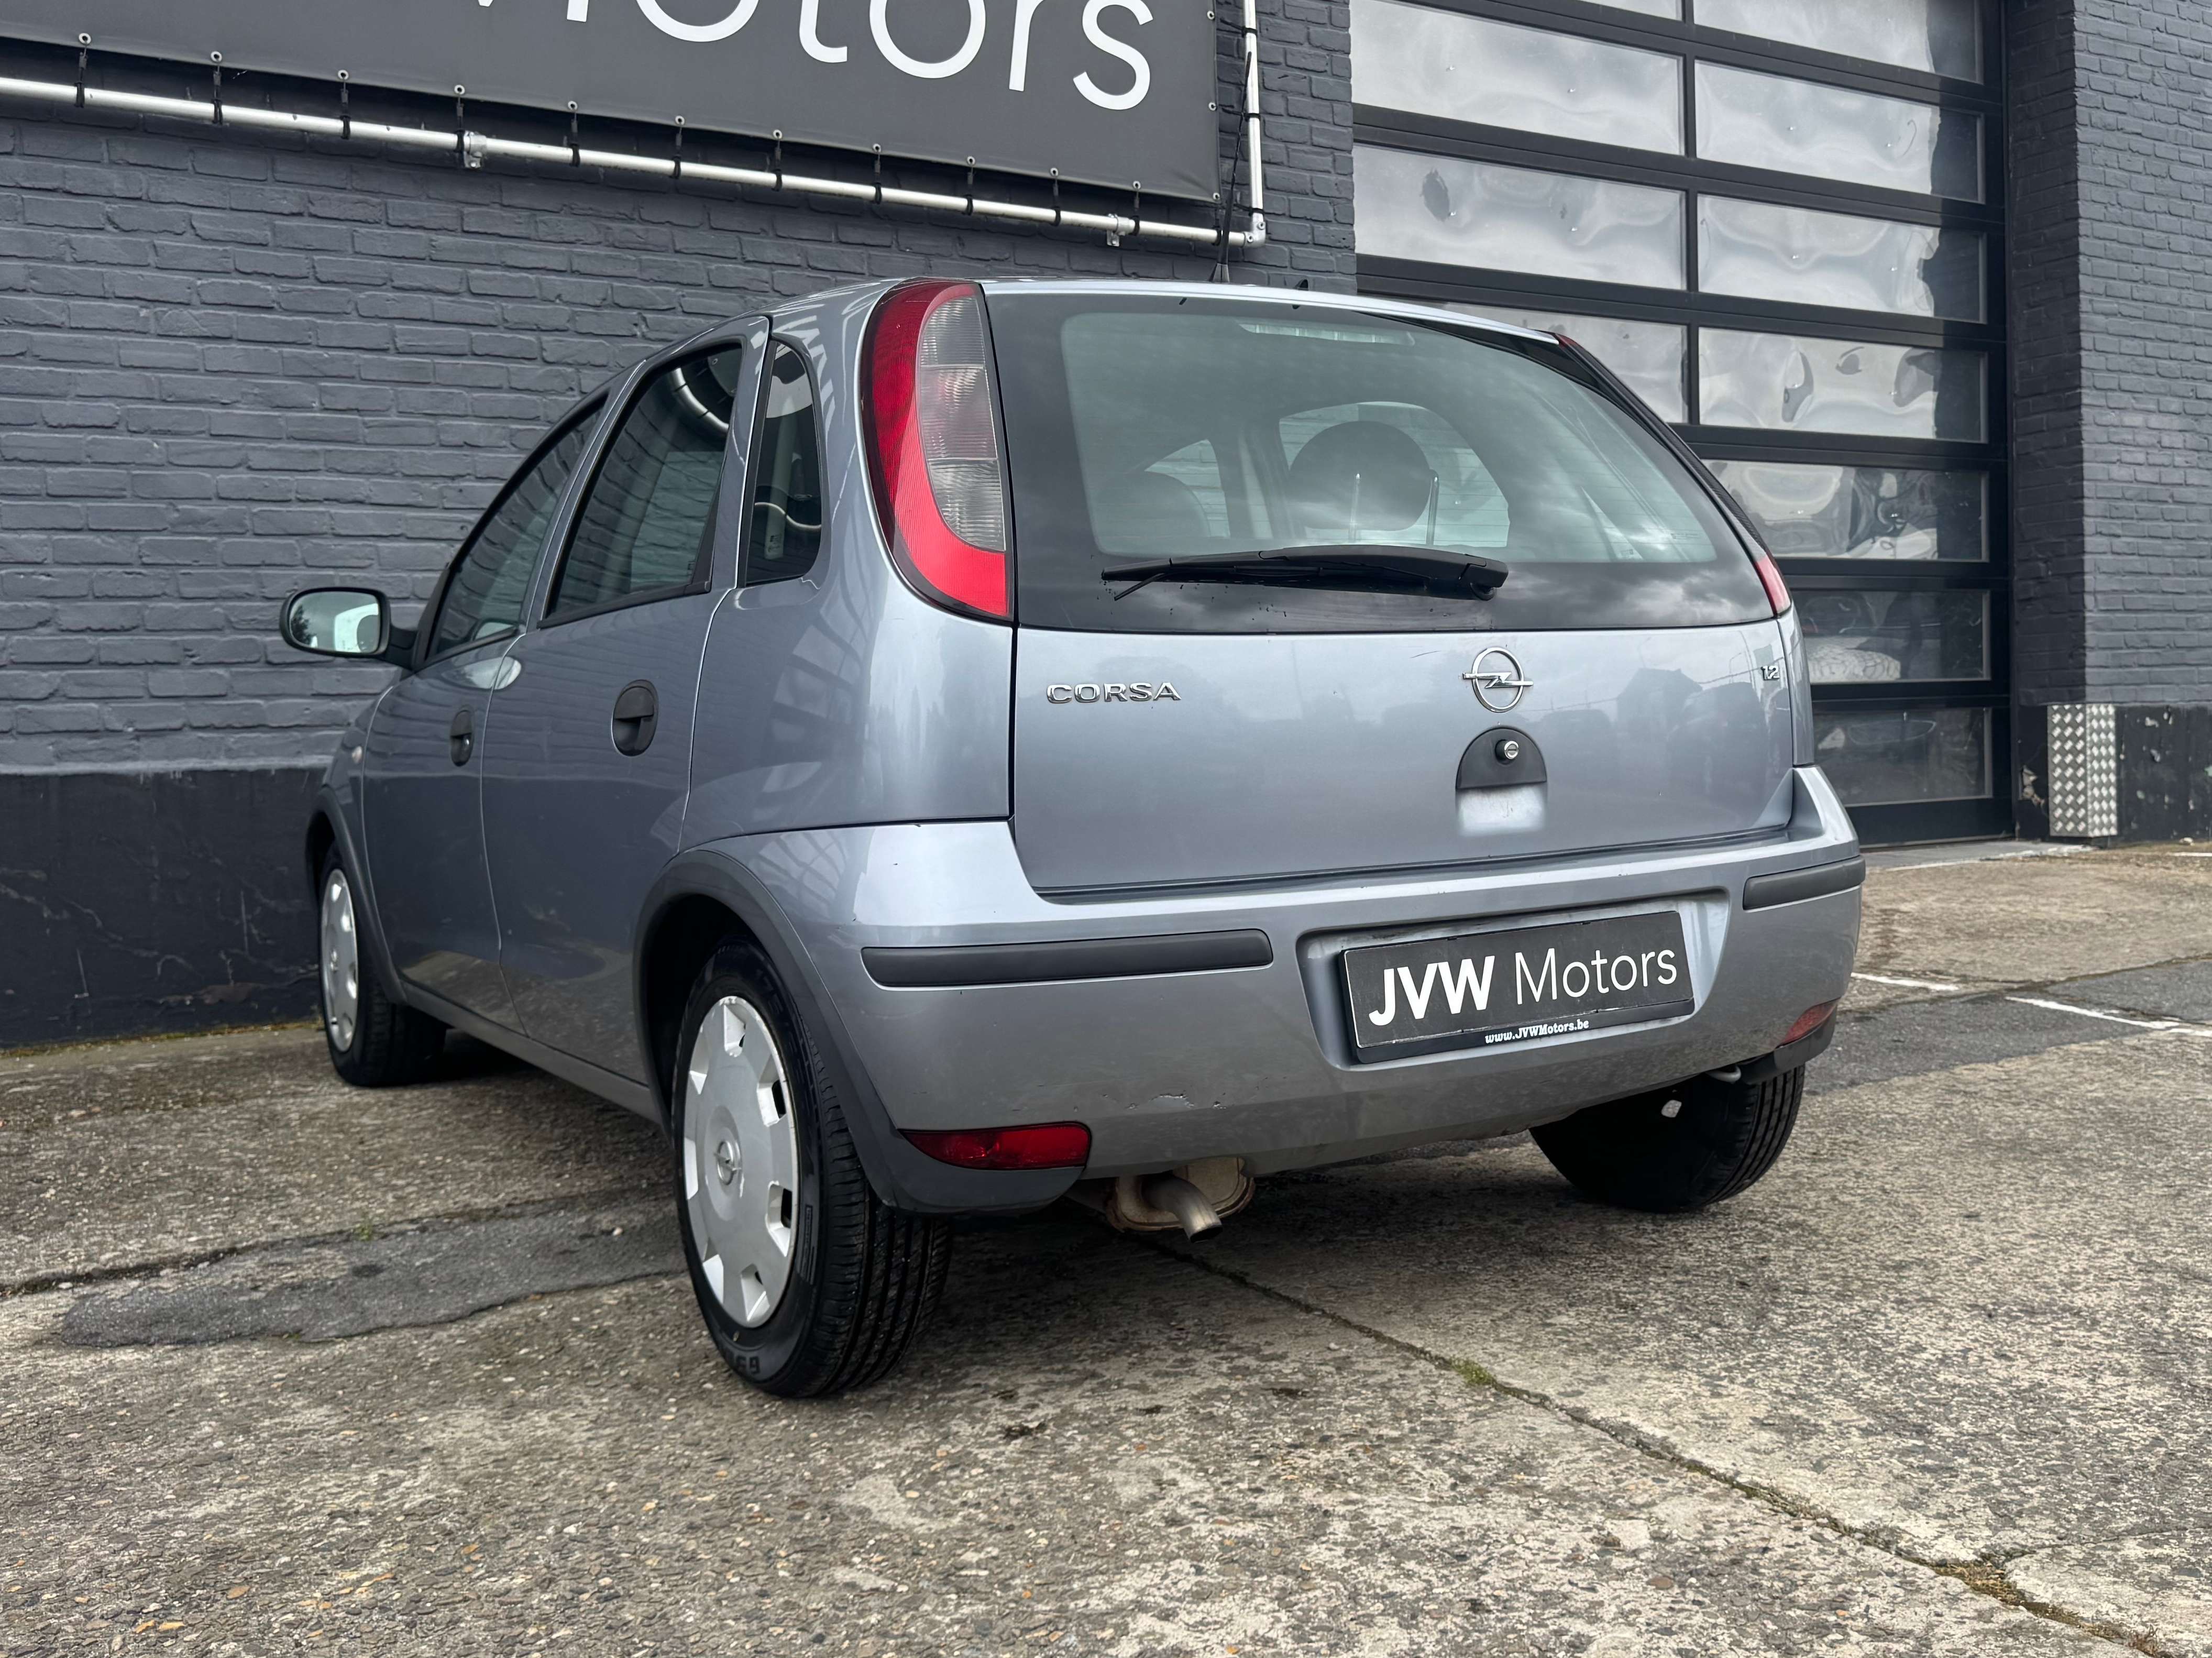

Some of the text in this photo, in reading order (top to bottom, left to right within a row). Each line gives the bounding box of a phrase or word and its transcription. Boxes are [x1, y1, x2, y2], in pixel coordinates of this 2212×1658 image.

[1047, 682, 1182, 704] CORSA
[1368, 948, 1677, 1026] JVW Motors
[1484, 1018, 1590, 1044] www.JVWMotors.be
